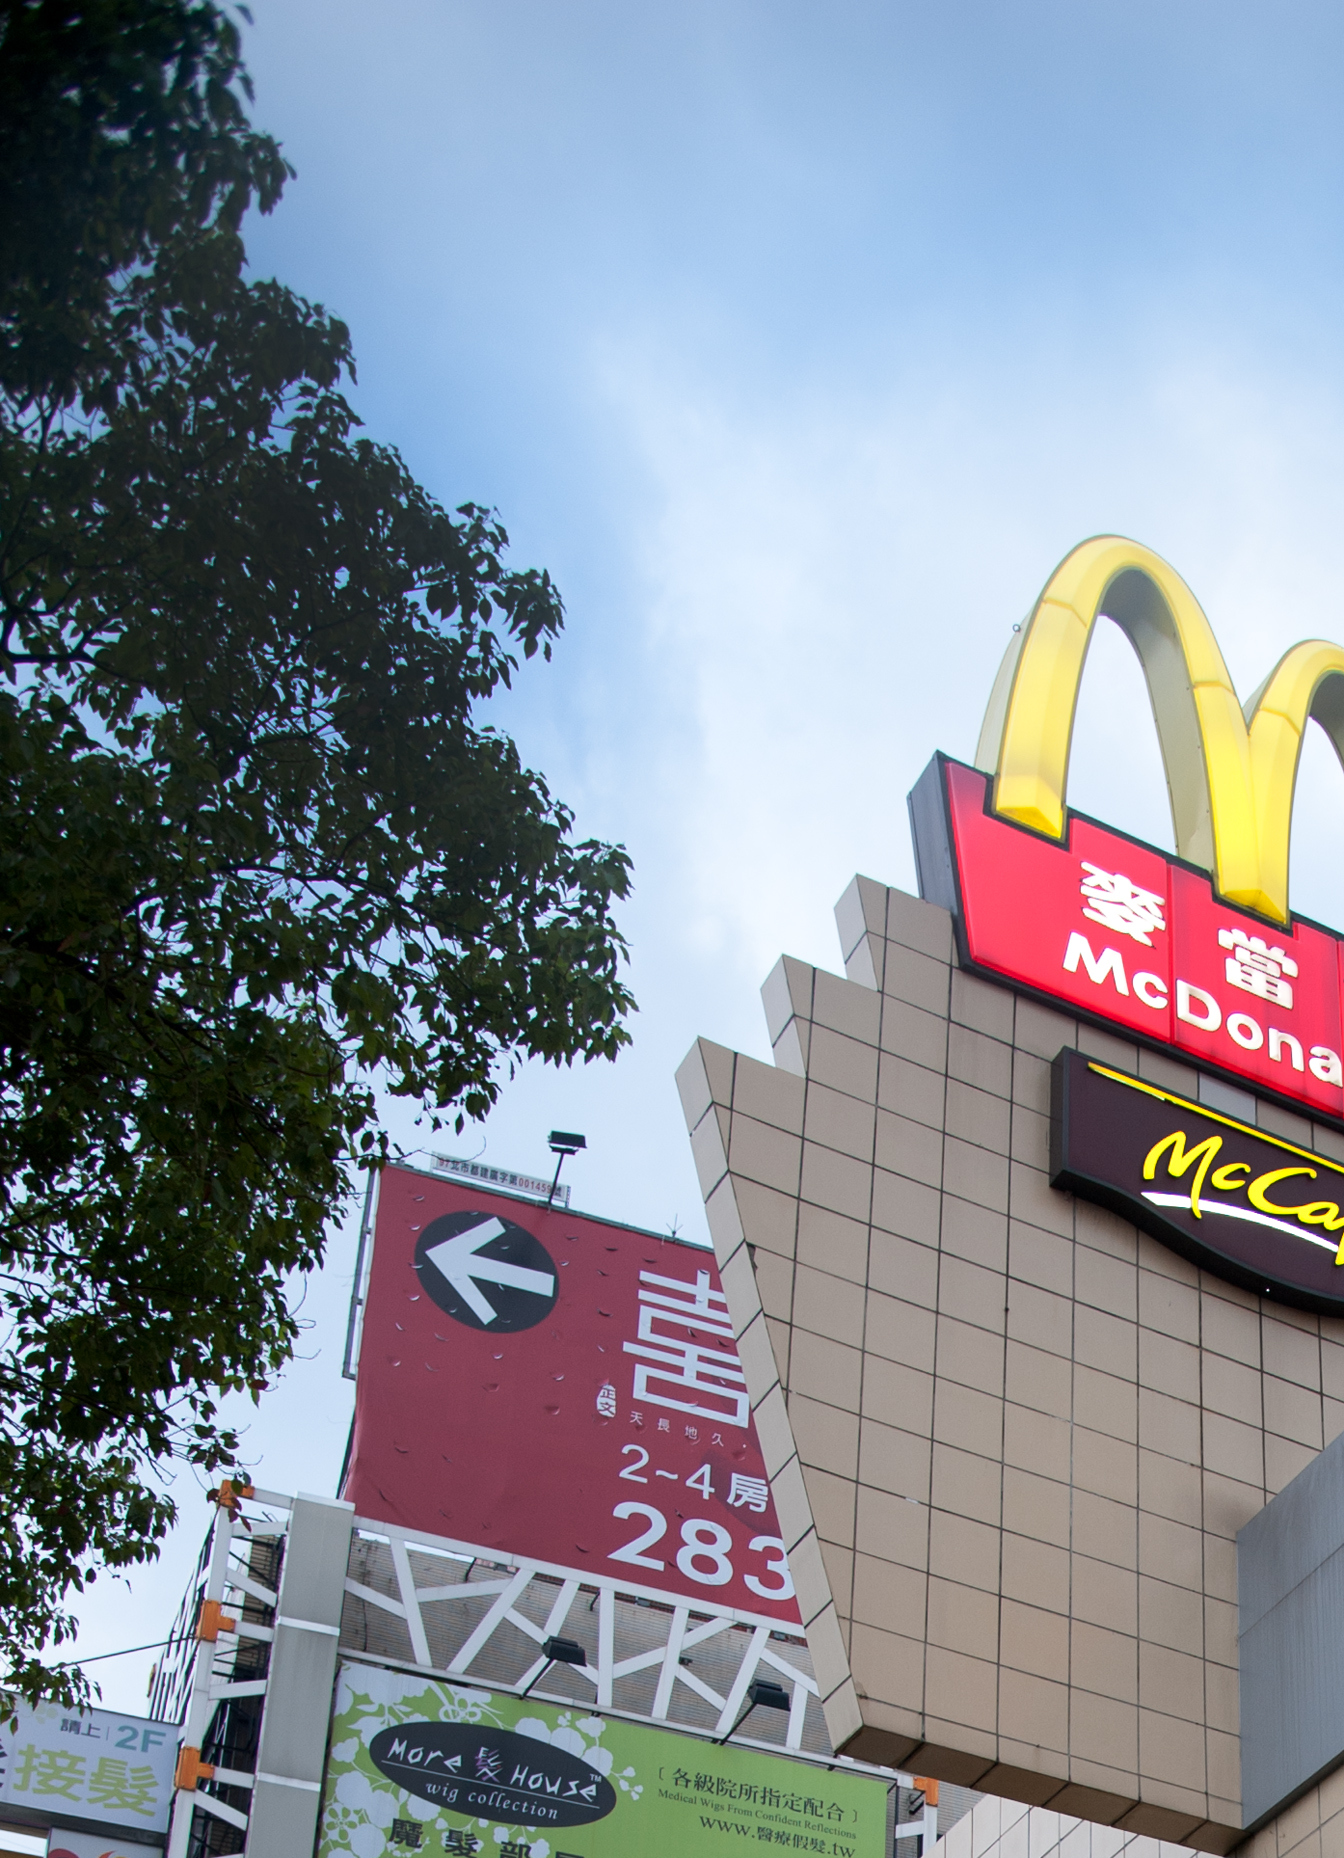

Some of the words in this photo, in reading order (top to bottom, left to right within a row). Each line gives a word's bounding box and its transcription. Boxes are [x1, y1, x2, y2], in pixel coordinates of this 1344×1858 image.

[630, 1410, 725, 1447] 天長地久
[606, 1500, 796, 1600] 283
[115, 1724, 167, 1753] 2F
[12, 1742, 160, 1818] 接髮
[387, 1737, 463, 1774] More
[509, 1763, 598, 1803] House
[425, 1781, 460, 1804] wig
[467, 1791, 559, 1820] collection
[658, 1788, 698, 1806] Medical
[700, 1797, 725, 1812] Wigs
[727, 1804, 754, 1818] From
[754, 1809, 802, 1828] Confident
[803, 1820, 857, 1840] Reflections
